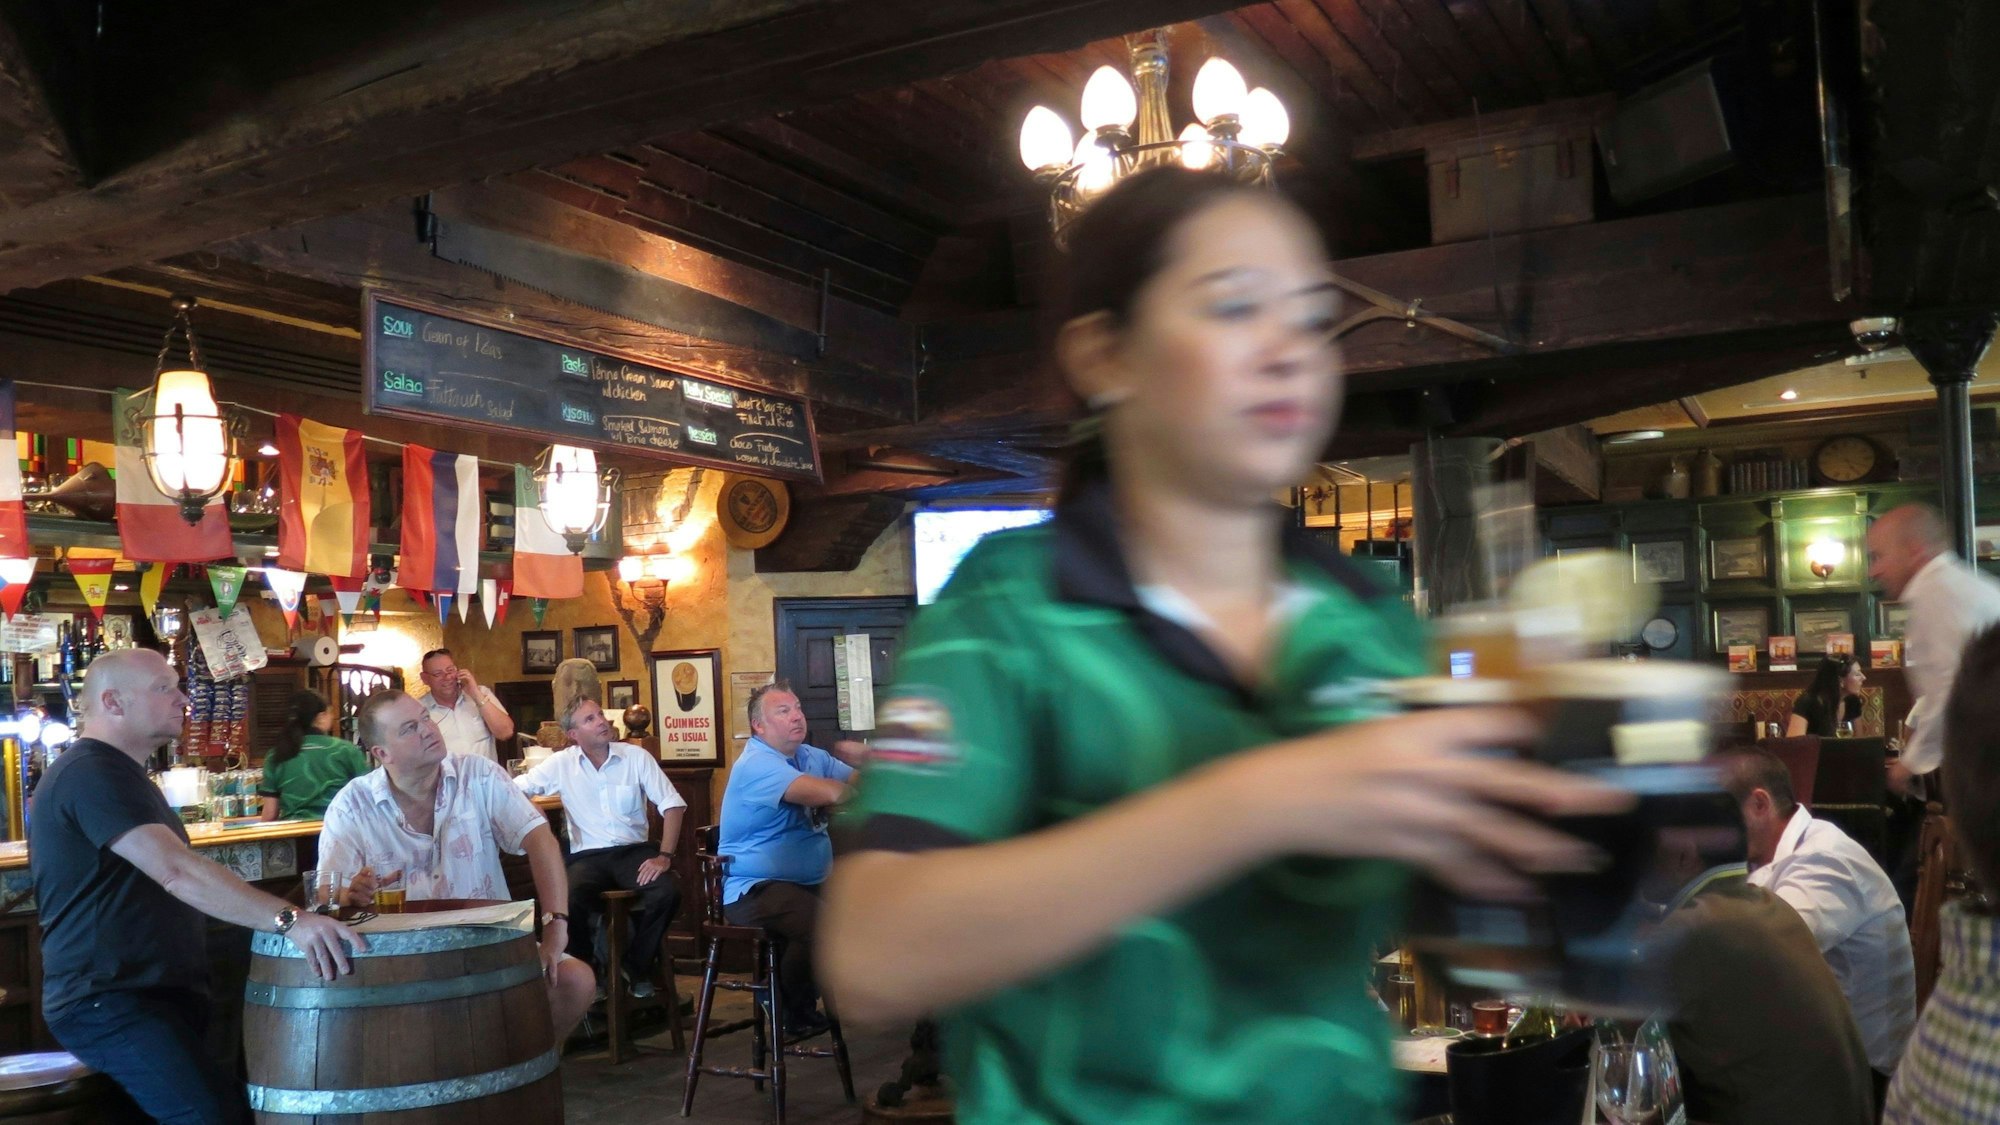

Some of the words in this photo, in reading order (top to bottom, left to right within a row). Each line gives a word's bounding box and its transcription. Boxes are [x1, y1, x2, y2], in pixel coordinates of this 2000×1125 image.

[561, 354, 588, 374] Pasta
[664, 715, 710, 729] GUINNESS
[668, 733, 679, 743] AS
[682, 732, 708, 743] USUAL
